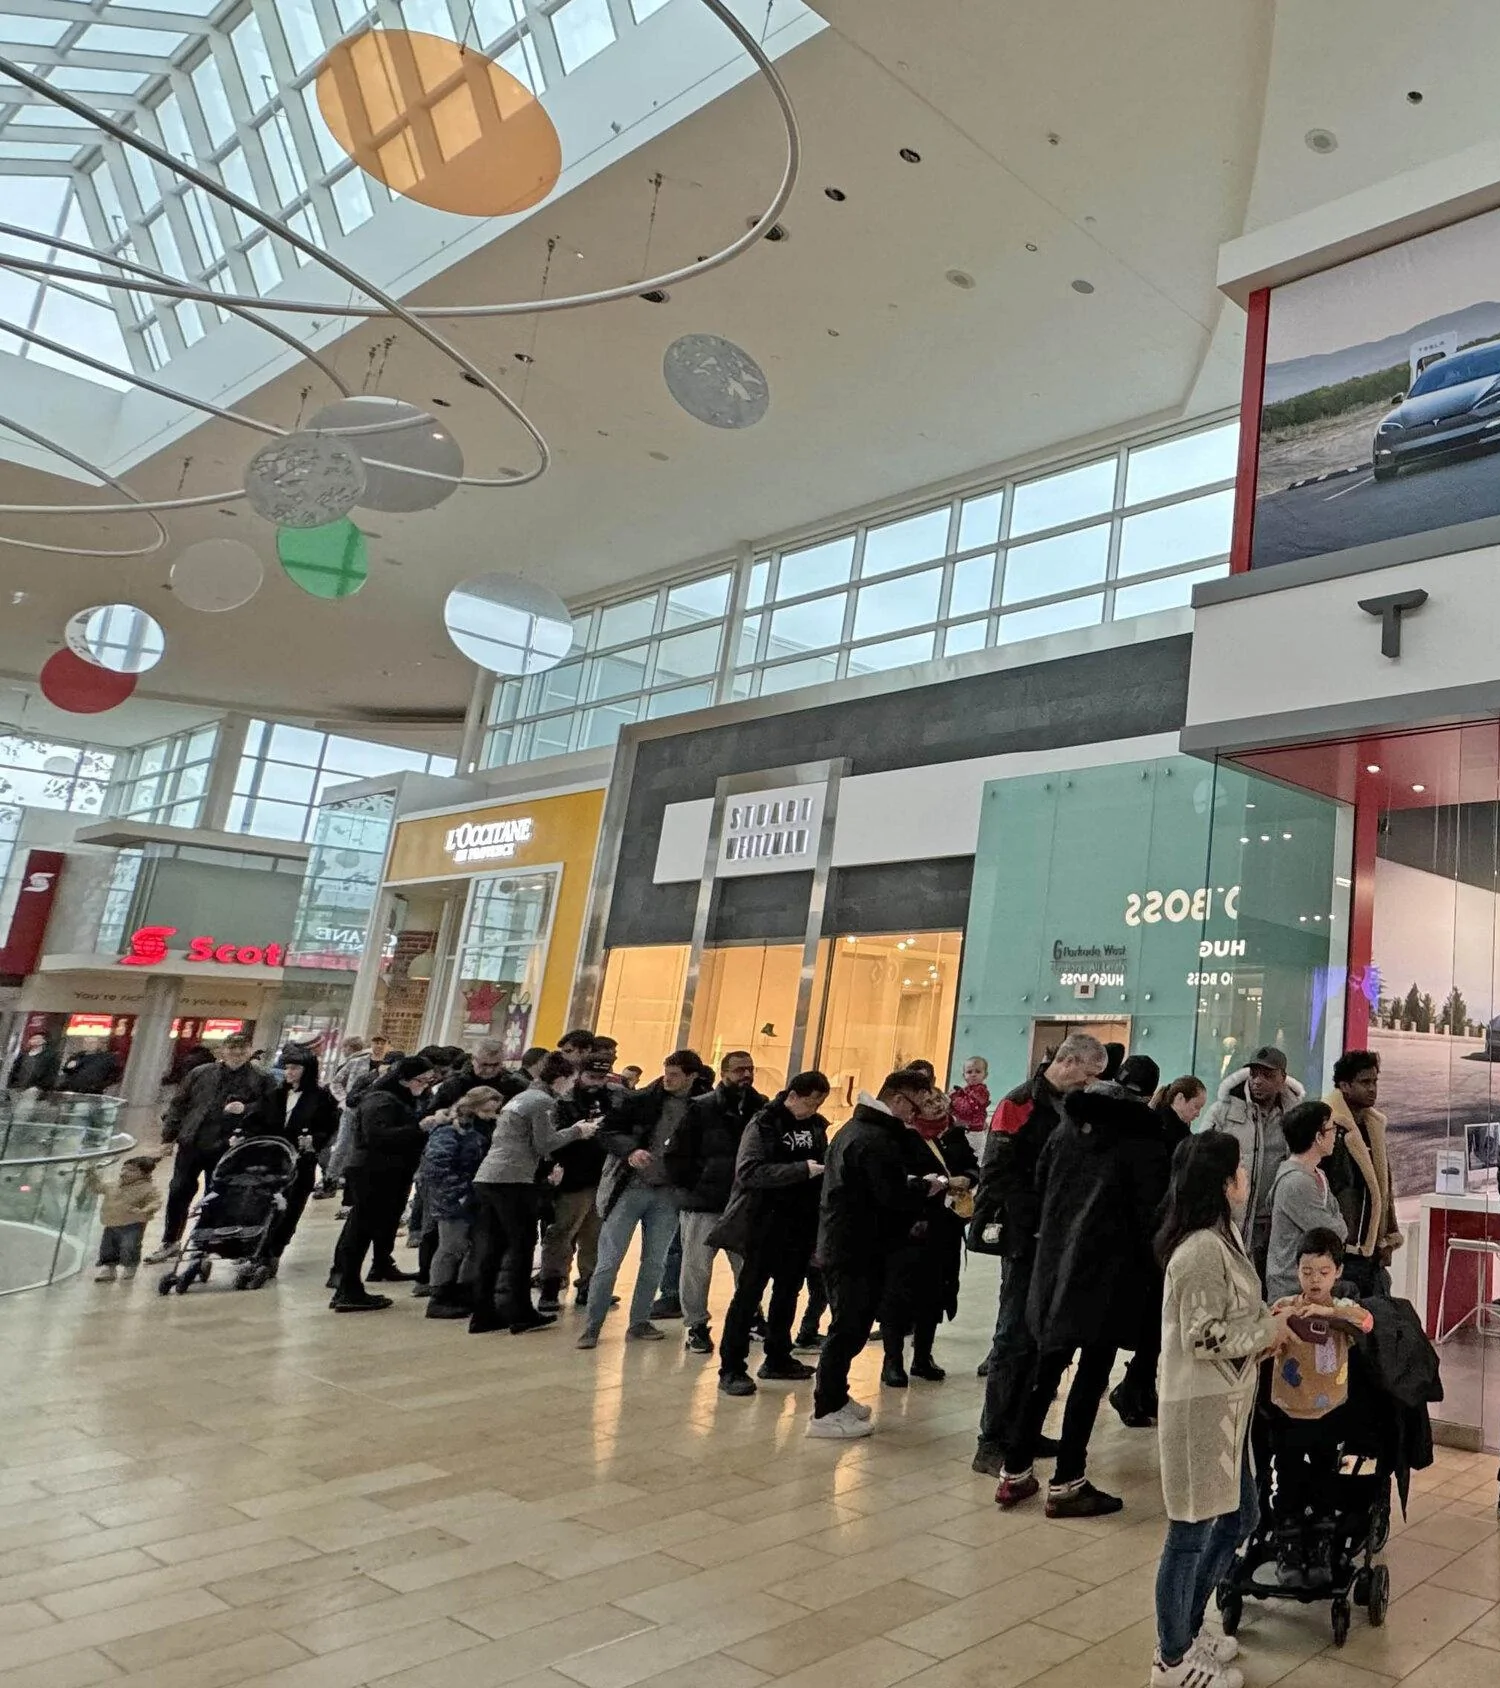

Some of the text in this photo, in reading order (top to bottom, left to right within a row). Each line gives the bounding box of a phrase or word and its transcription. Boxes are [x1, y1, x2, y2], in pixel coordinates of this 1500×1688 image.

[731, 798, 811, 829] STUART
[444, 818, 532, 851] L'OCCITANE
[726, 829, 809, 861] WEITZMAN
